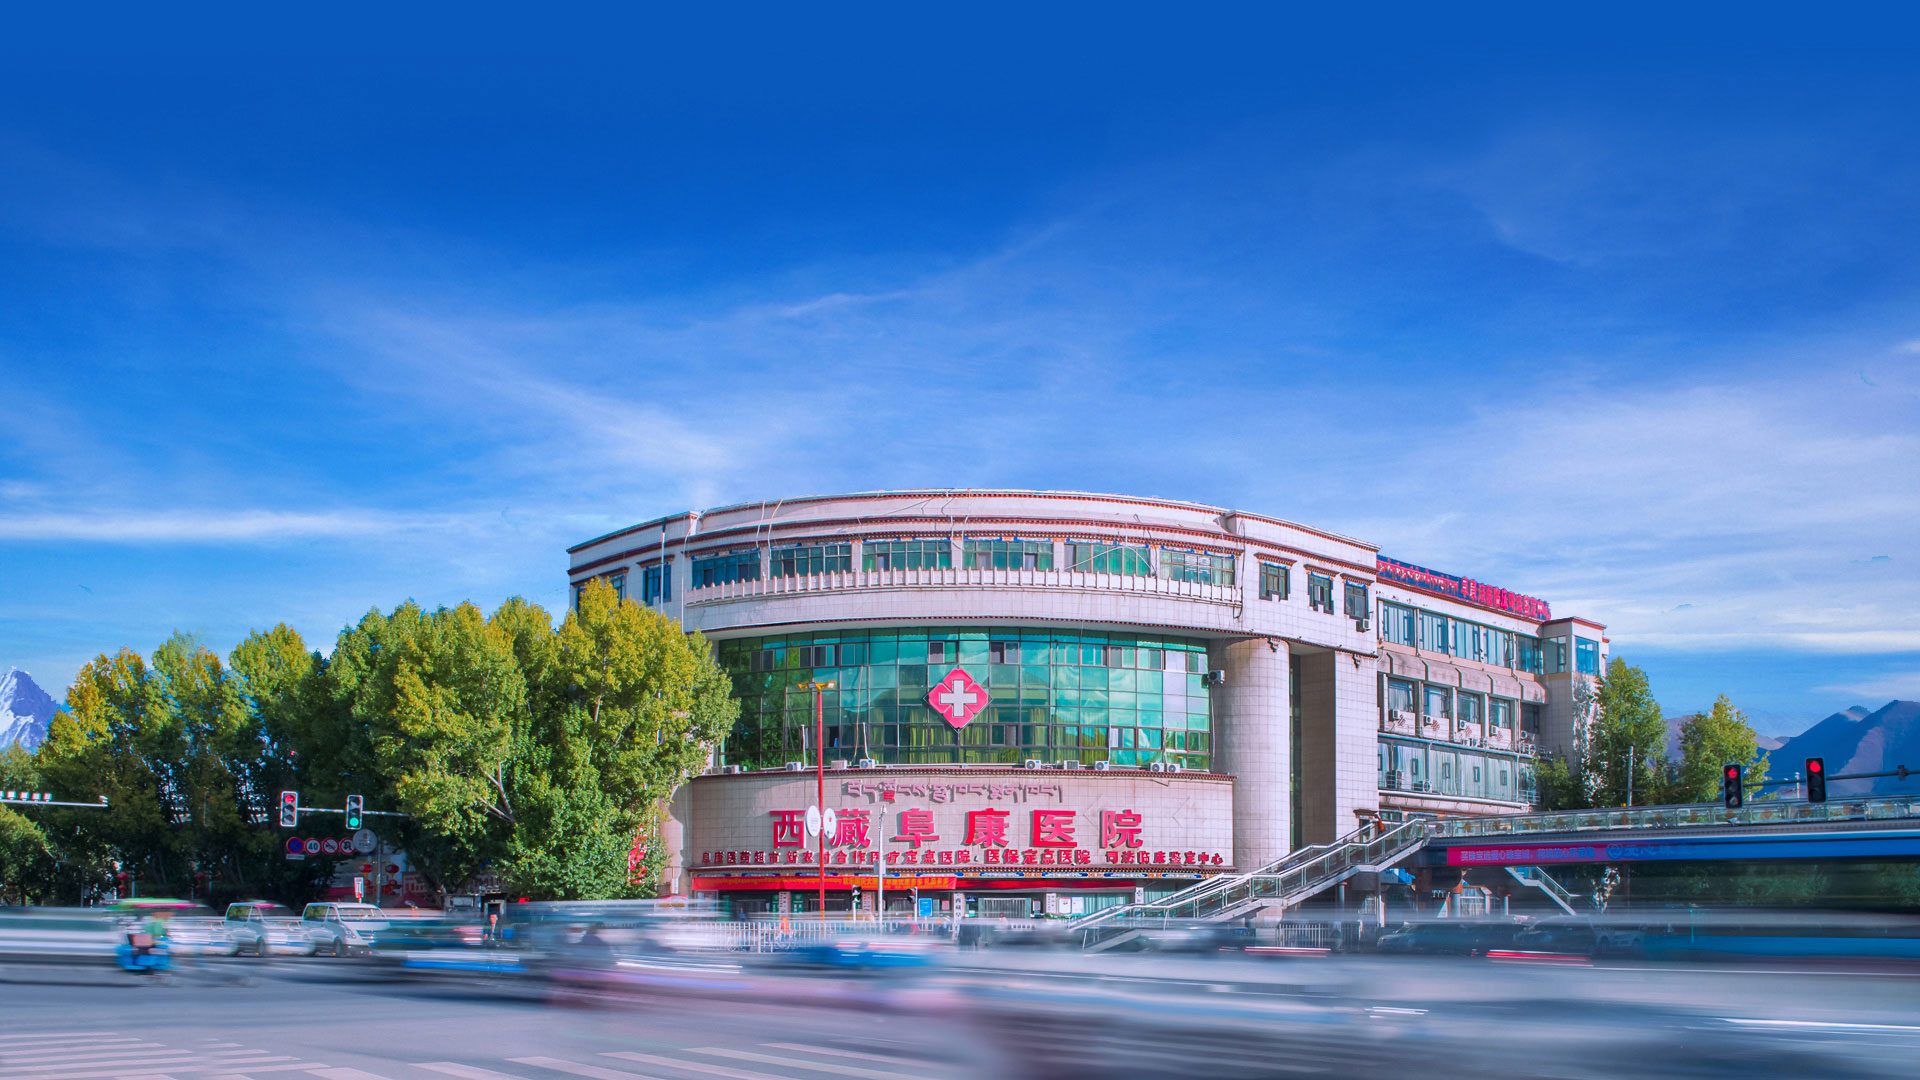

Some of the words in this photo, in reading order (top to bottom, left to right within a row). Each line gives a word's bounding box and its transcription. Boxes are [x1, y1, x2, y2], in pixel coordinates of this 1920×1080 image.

[769, 808, 1143, 848] 西藏阜康医院
[308, 842, 319, 850] 40
[702, 851, 780, 865] 阜康医药超市
[1106, 850, 1224, 865] 司法临床鉴定中心
